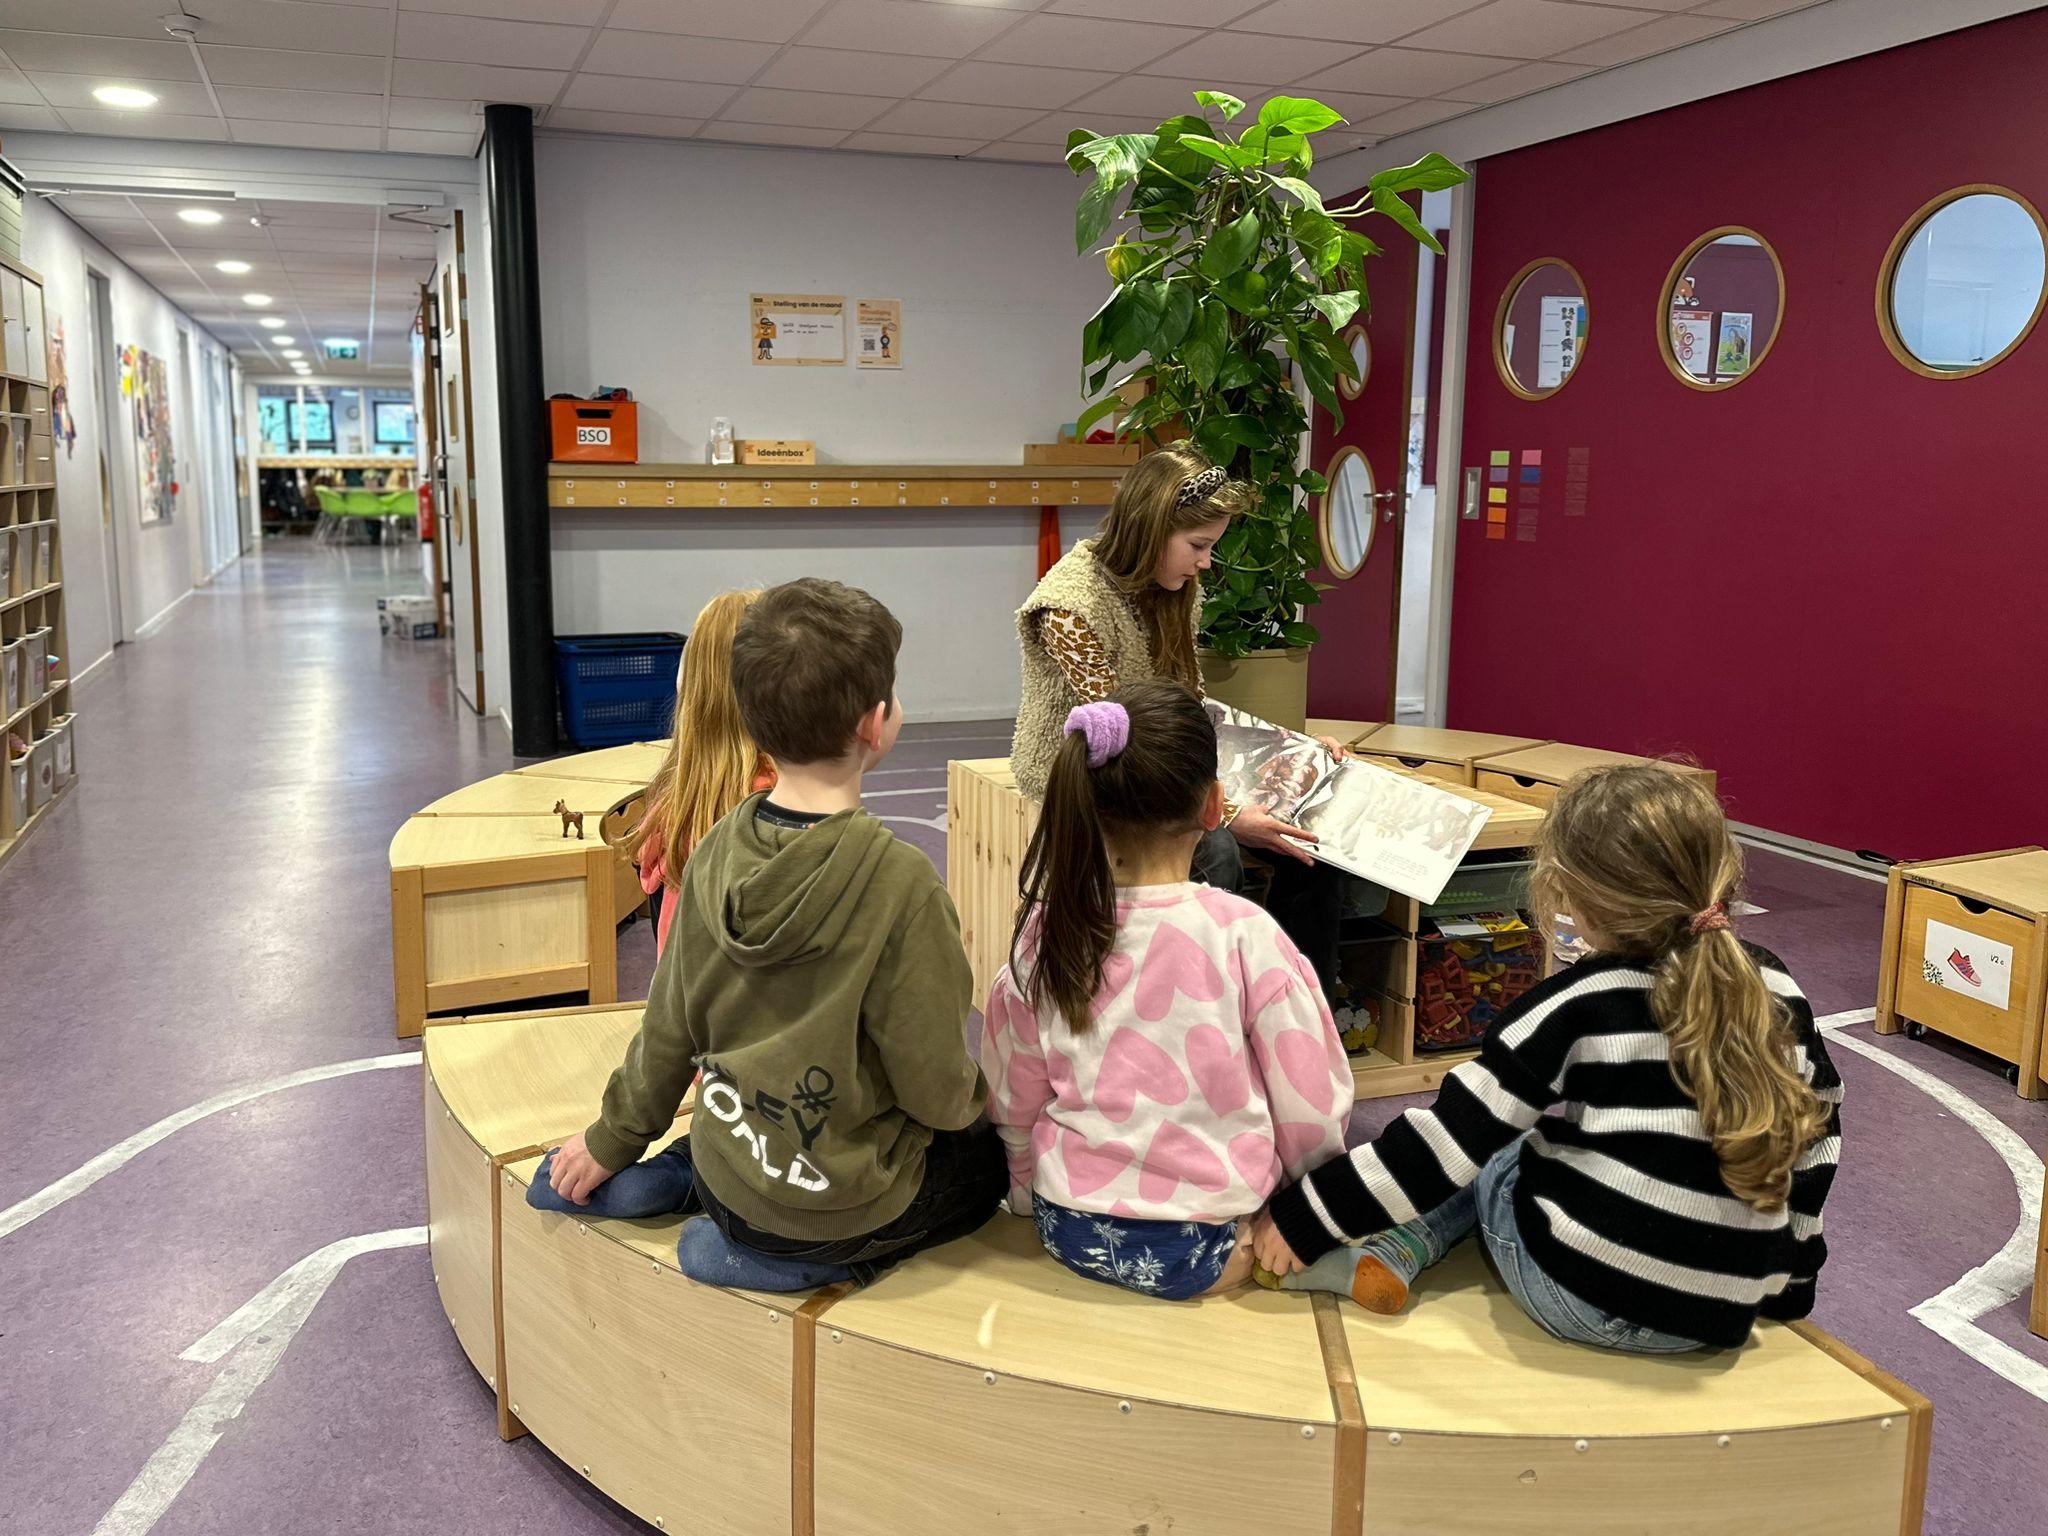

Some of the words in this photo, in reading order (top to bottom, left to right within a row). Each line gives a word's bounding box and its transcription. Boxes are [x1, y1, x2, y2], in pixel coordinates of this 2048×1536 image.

[578, 429, 608, 443] BSO
[757, 448, 805, 457] Ideeënbox
[743, 1089, 828, 1152] EY
